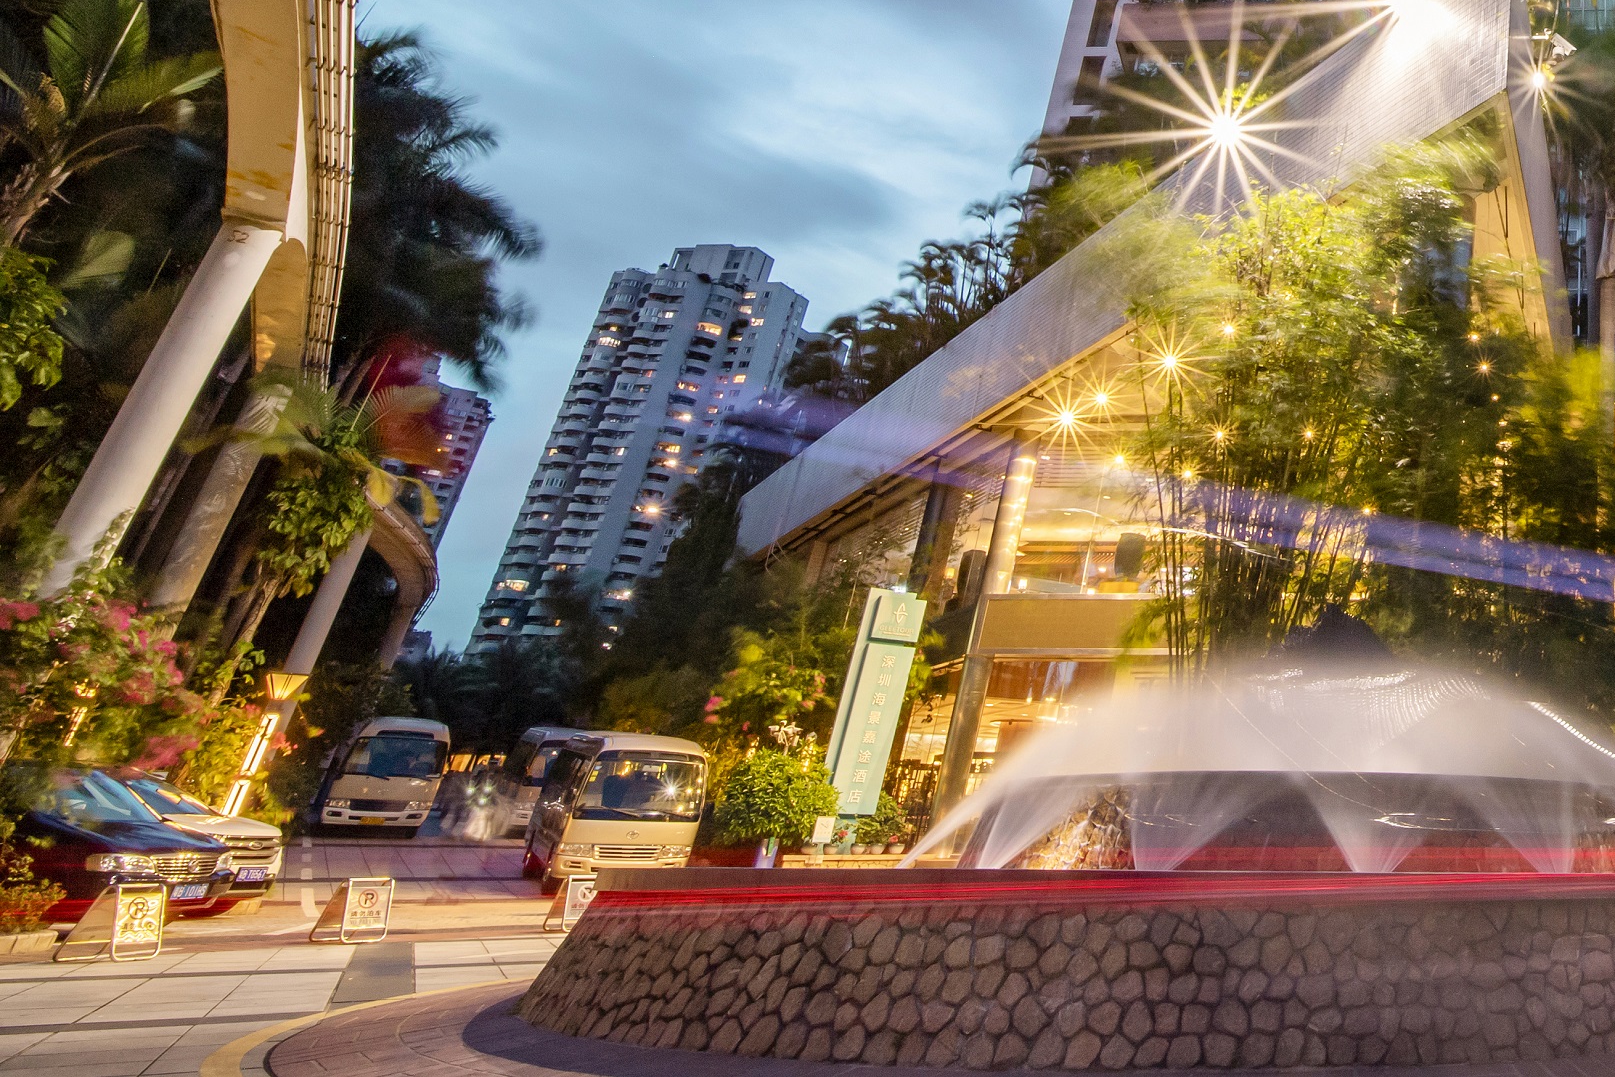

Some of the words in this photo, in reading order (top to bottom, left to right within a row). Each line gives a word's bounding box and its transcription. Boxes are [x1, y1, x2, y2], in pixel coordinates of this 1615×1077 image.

[846, 654, 896, 804] 深圳海景嘉途酒店
